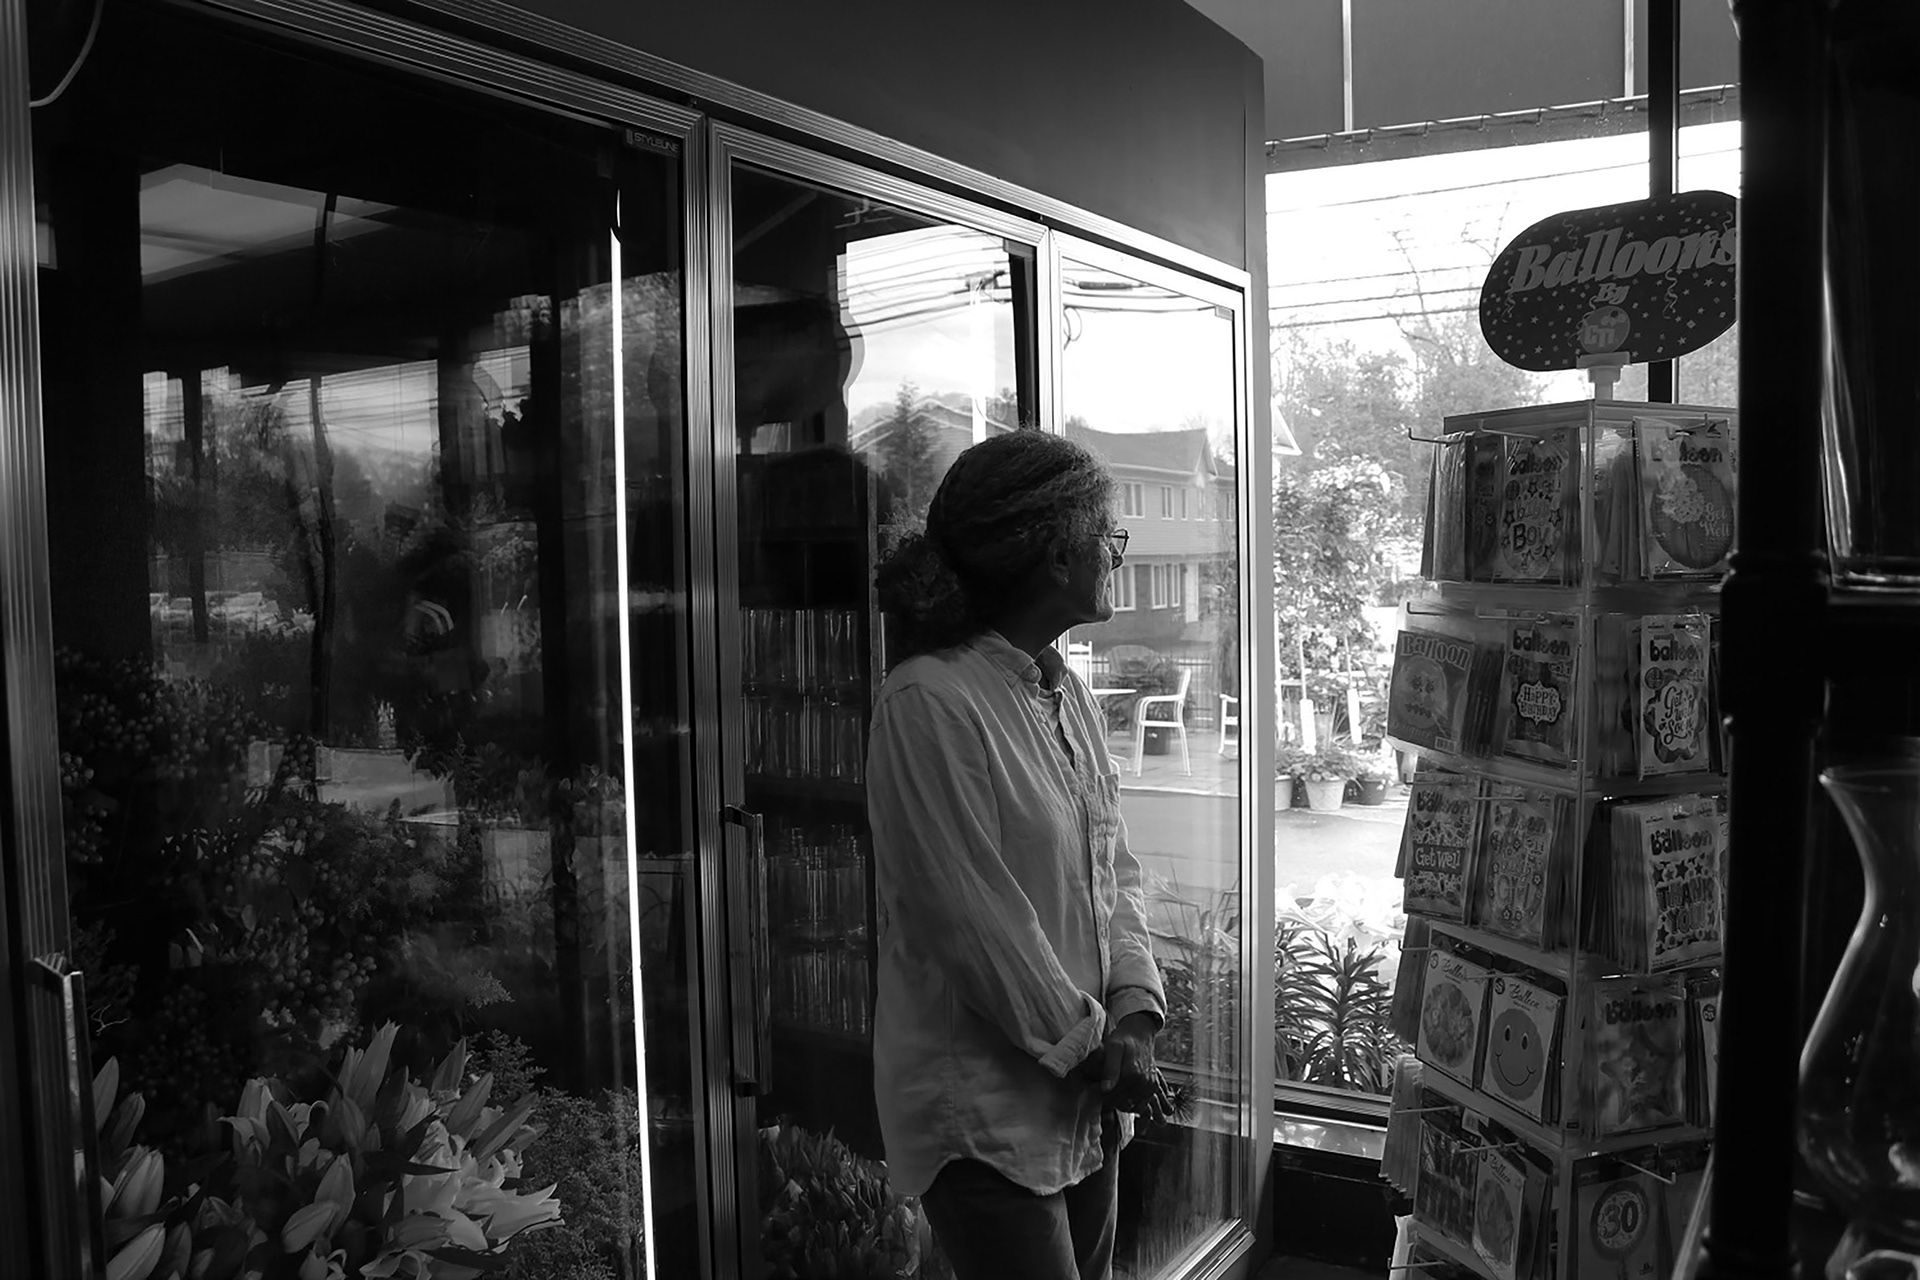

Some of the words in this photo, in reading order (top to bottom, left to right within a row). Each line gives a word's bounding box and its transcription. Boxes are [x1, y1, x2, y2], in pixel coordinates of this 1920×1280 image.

[1507, 227, 1735, 293] Balloons
[1594, 283, 1630, 305] By
[1514, 629, 1570, 656] balloon
[1649, 639, 1704, 661] balloon
[1417, 791, 1470, 815] balloon
[1651, 829, 1713, 855] balloon
[1415, 847, 1436, 867] Get
[1437, 849, 1461, 869] Well
[1656, 877, 1715, 911] THANK
[1606, 999, 1677, 1025] balloon
[1600, 1200, 1639, 1239] 30
